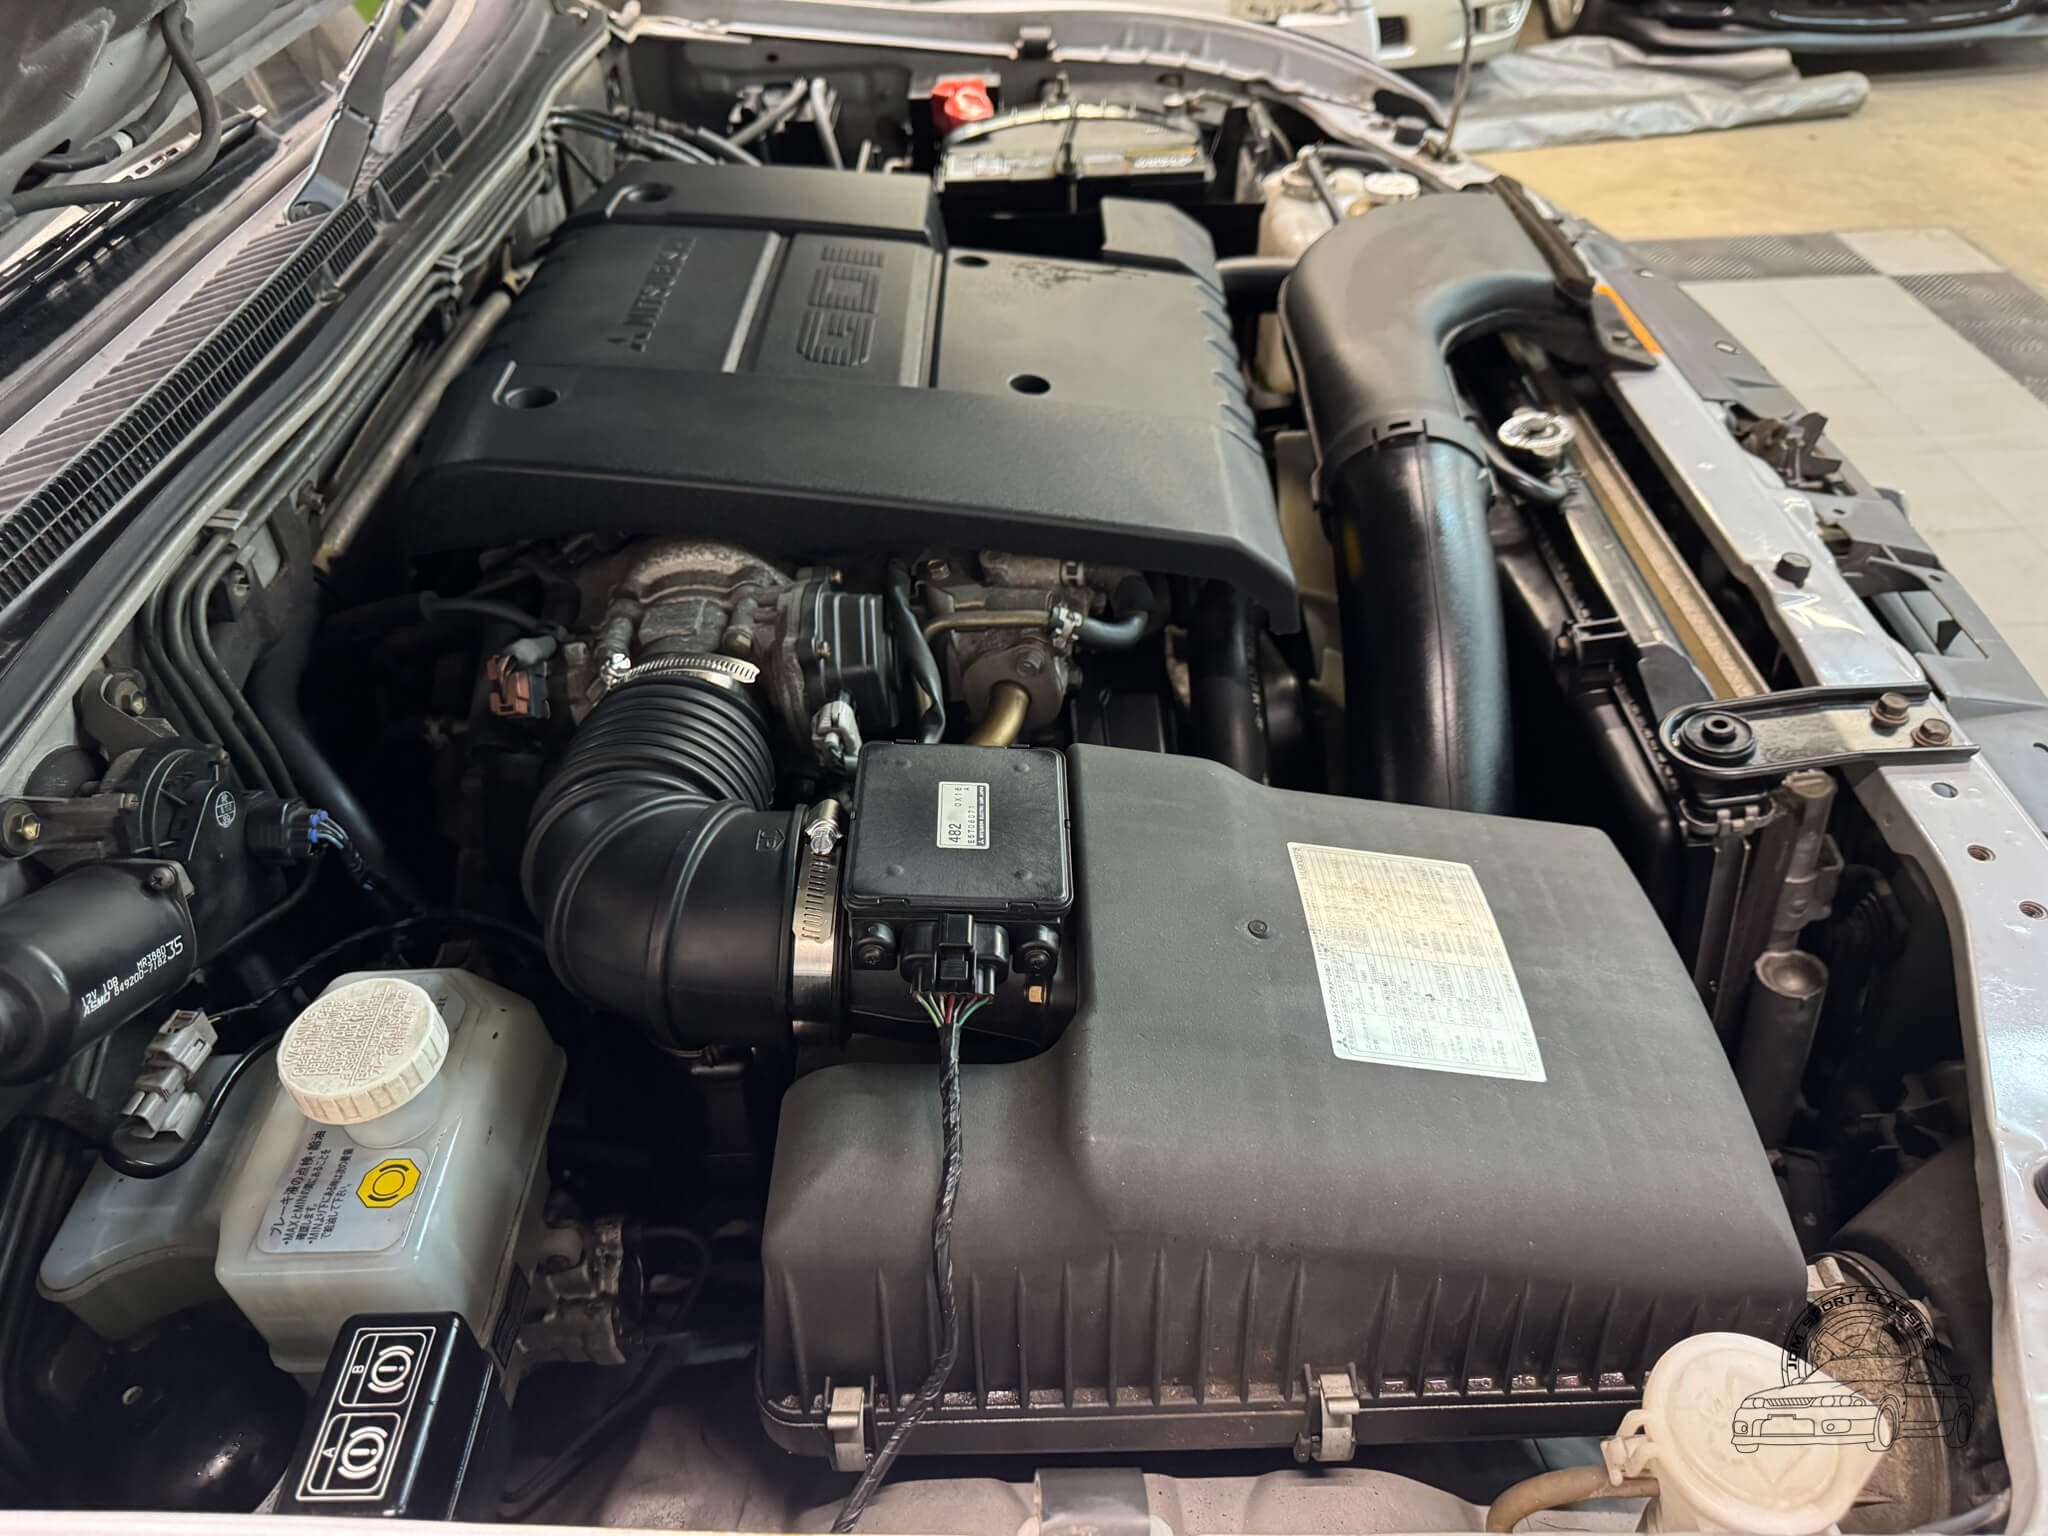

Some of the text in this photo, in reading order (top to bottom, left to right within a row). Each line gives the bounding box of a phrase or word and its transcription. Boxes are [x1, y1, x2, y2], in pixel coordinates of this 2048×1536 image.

[622, 237, 697, 330] MITSUBISHI
[797, 246, 884, 367] GDI
[948, 823, 962, 843] 482
[81, 988, 97, 1008] 12V
[83, 991, 112, 1018] ASMO
[351, 1364, 365, 1375] B
[322, 1446, 336, 1459] A
